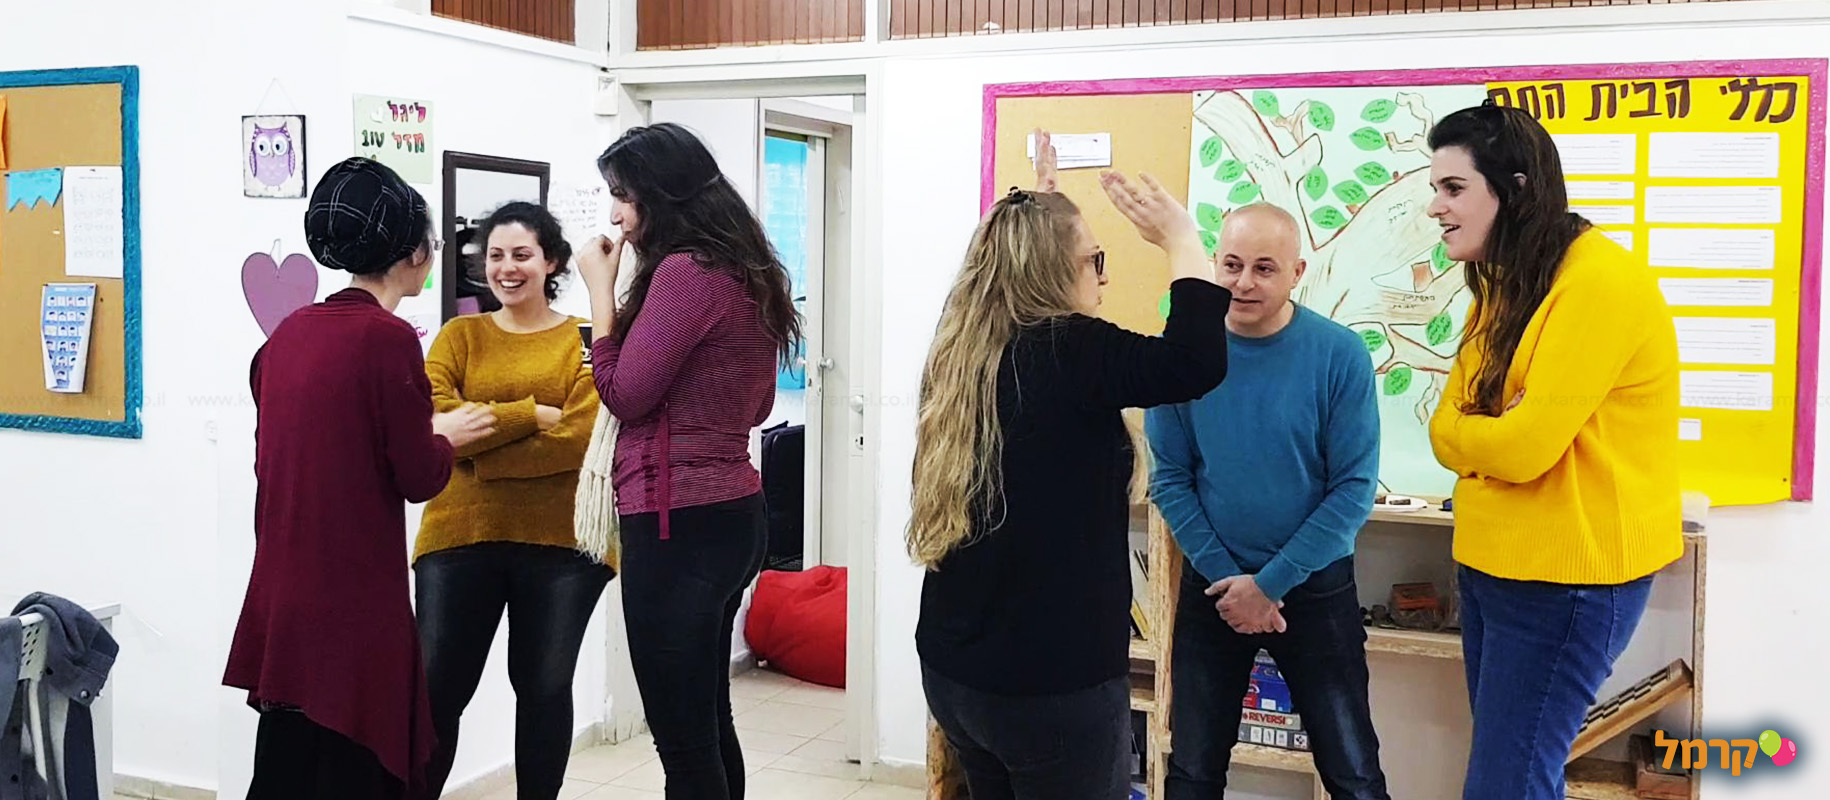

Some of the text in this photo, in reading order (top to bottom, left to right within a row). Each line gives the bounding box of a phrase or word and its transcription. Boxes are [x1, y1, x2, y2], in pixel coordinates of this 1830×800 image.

[1583, 80, 1691, 122] הבית
[1720, 78, 1797, 123] כללי
[361, 129, 385, 148] טוב
[1248, 712, 1286, 725] REVERSI
